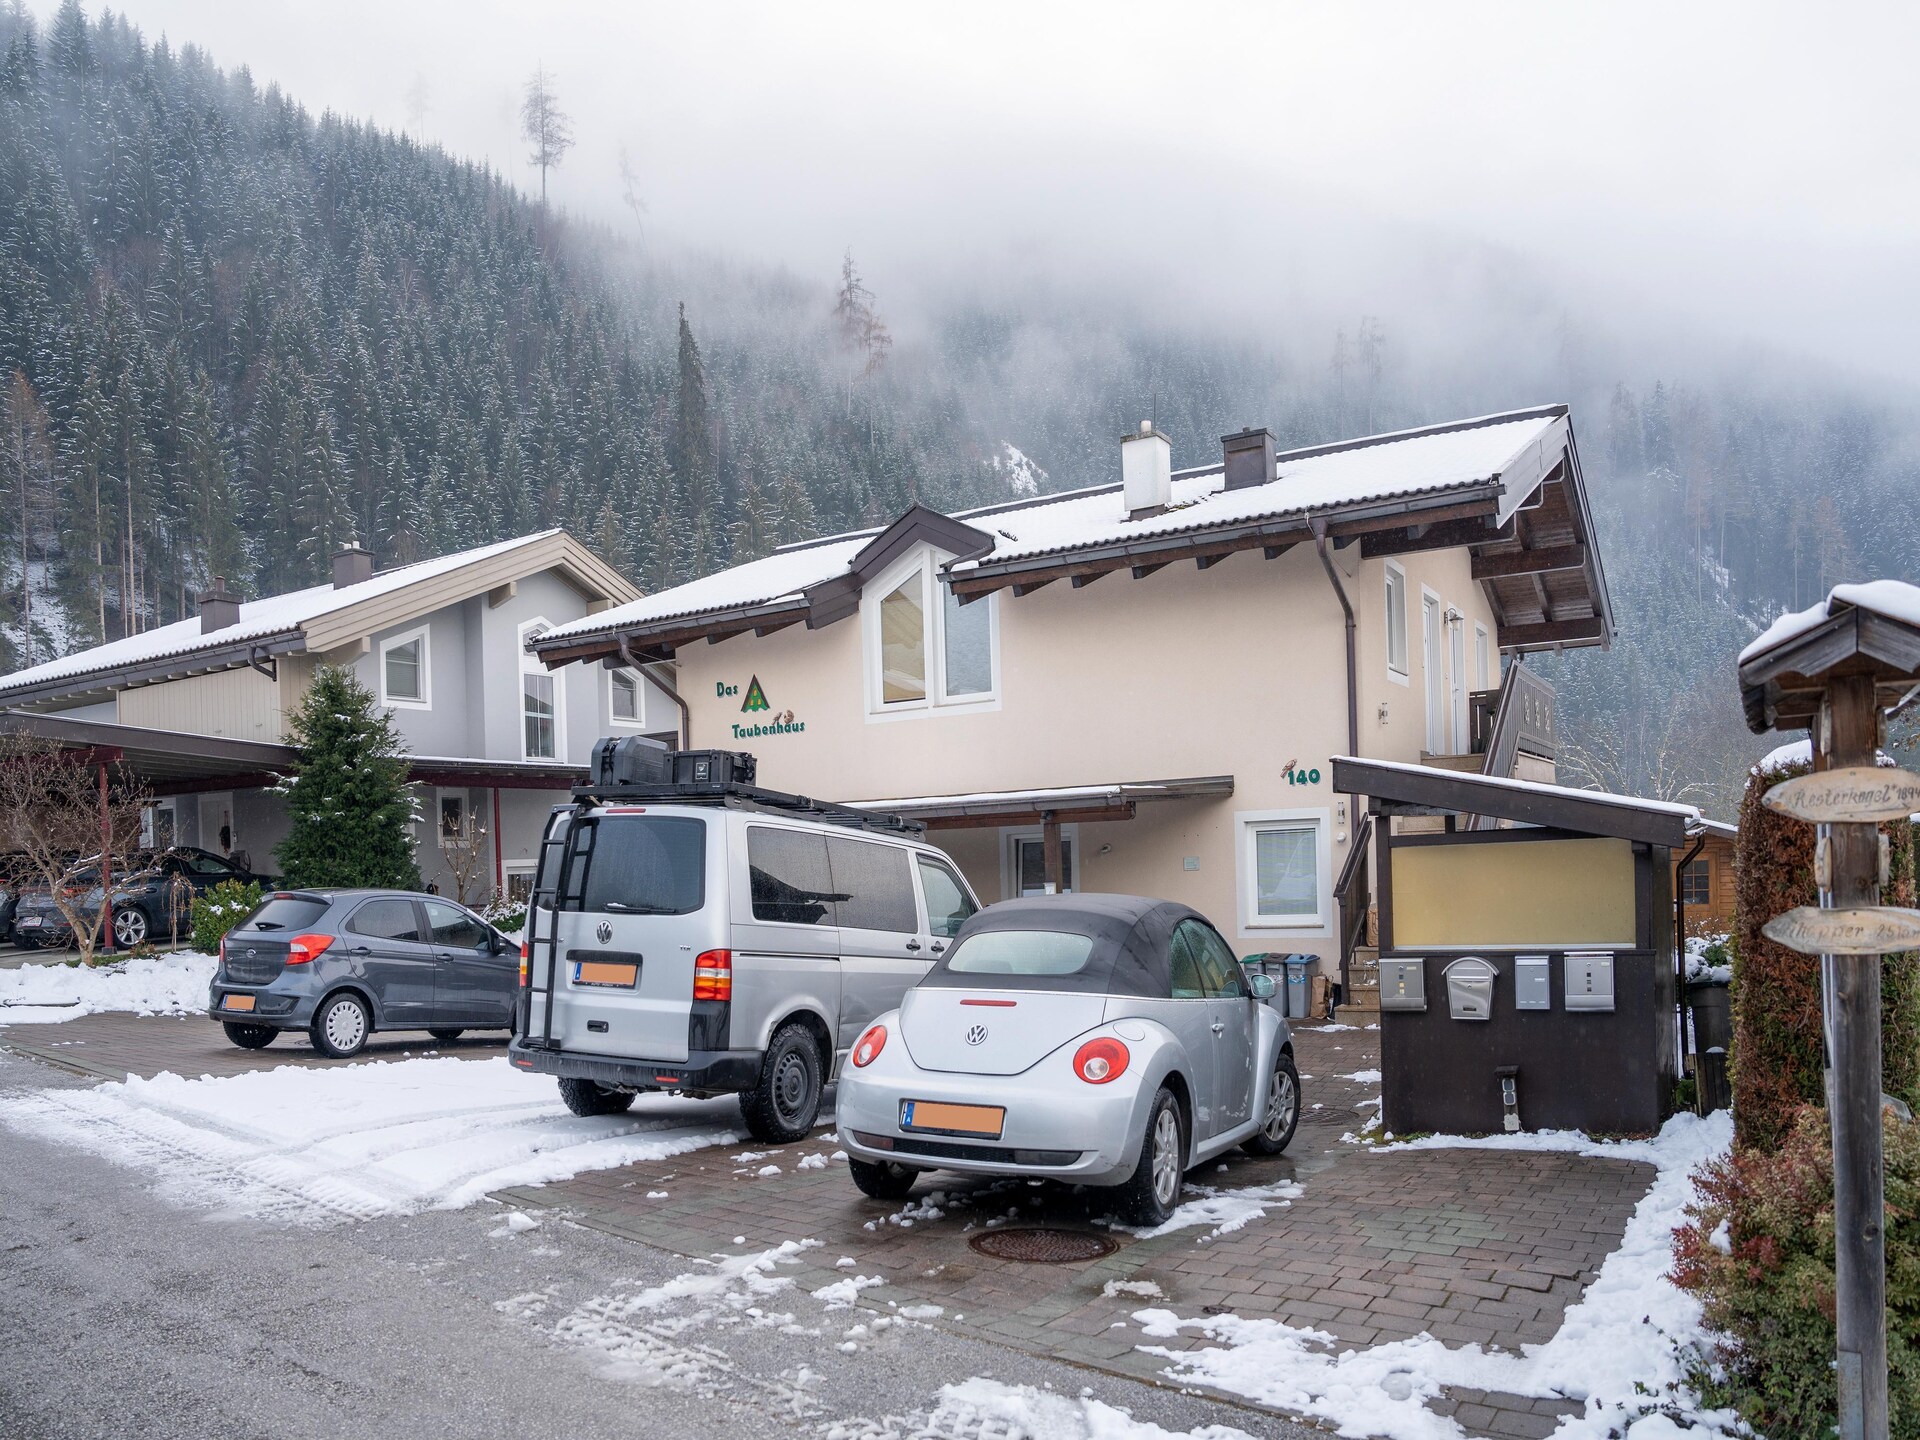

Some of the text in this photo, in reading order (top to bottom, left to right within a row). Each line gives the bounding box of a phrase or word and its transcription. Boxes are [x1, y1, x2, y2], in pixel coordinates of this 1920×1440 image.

[716, 681, 739, 697] Das
[732, 721, 805, 739] Taubenhaus
[1287, 768, 1321, 786] 140
